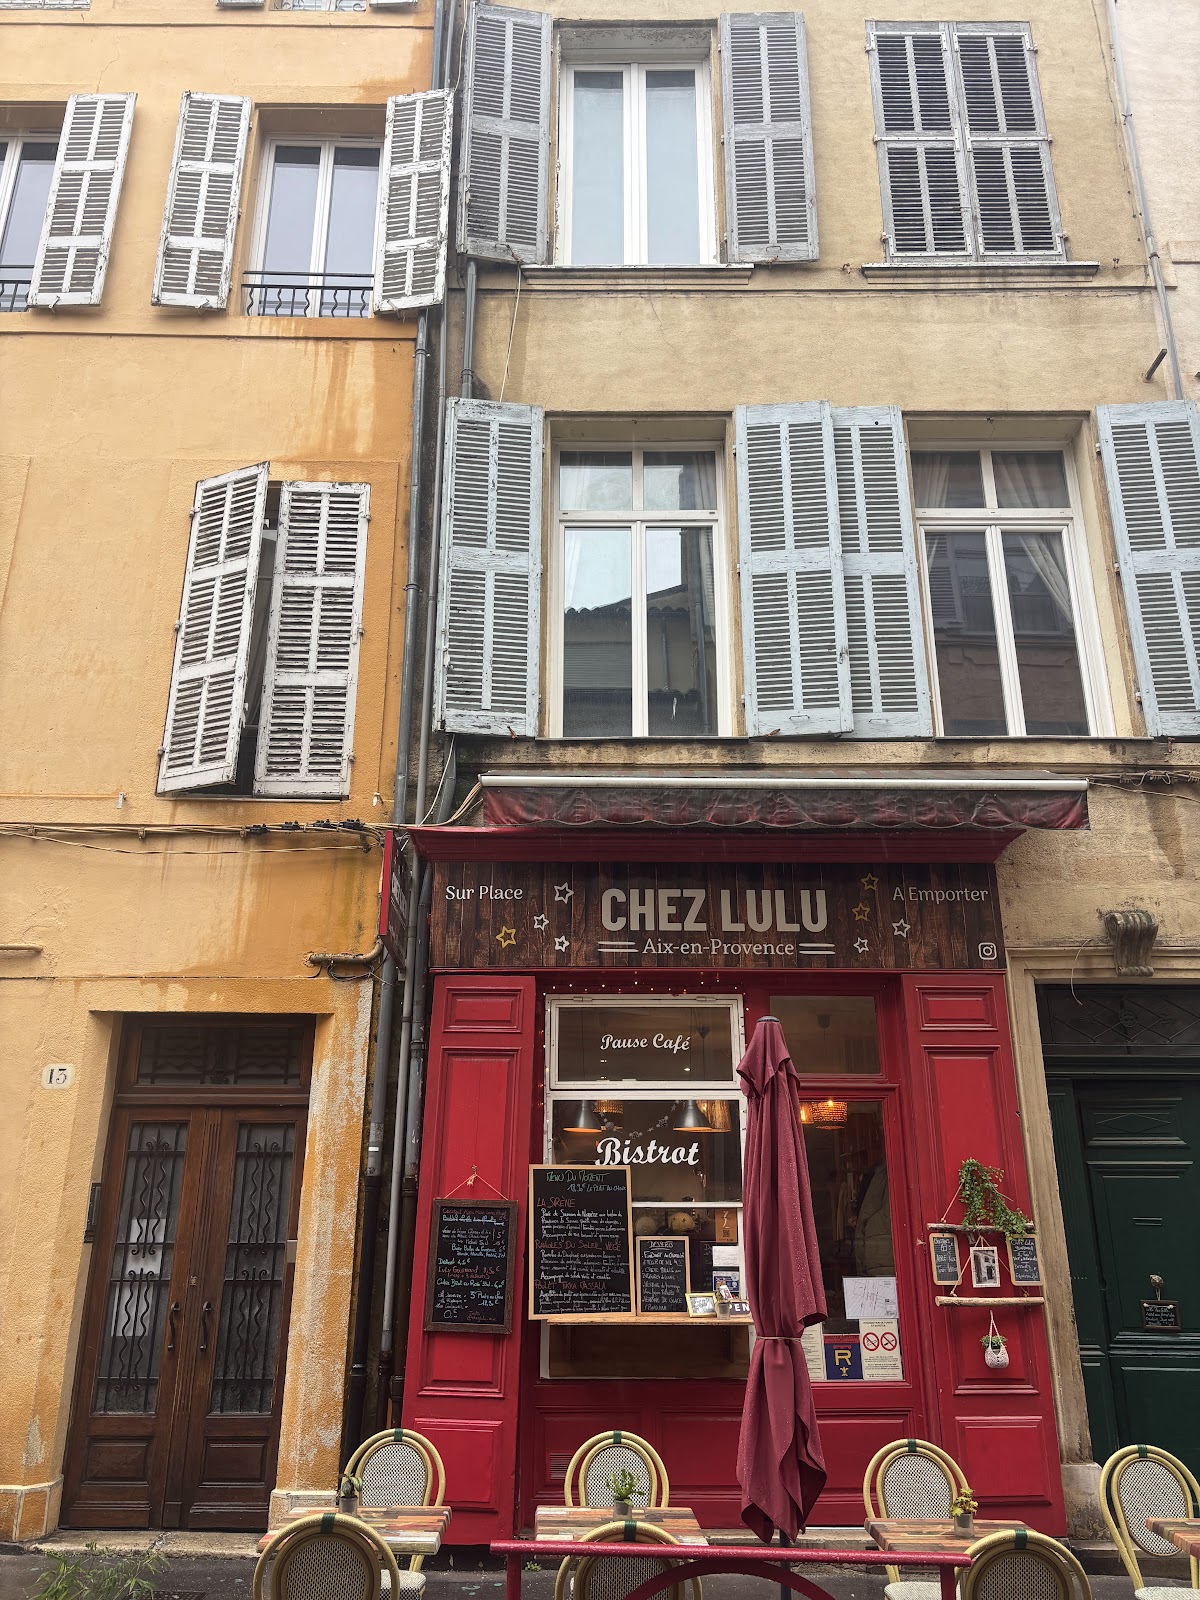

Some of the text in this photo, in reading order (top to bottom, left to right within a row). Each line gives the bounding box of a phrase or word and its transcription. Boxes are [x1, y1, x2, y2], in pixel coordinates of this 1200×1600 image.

[445, 885, 523, 901] Sur Place
[893, 887, 988, 904] A Emporter
[601, 888, 828, 933] CHEZ LULU
[642, 937, 795, 957] Aix-en-Provence
[600, 1033, 691, 1054] Pause Café
[47, 1068, 67, 1084] 13
[595, 1137, 699, 1166] Bistrot
[729, 1303, 750, 1312] EN
[834, 1349, 852, 1366] R
